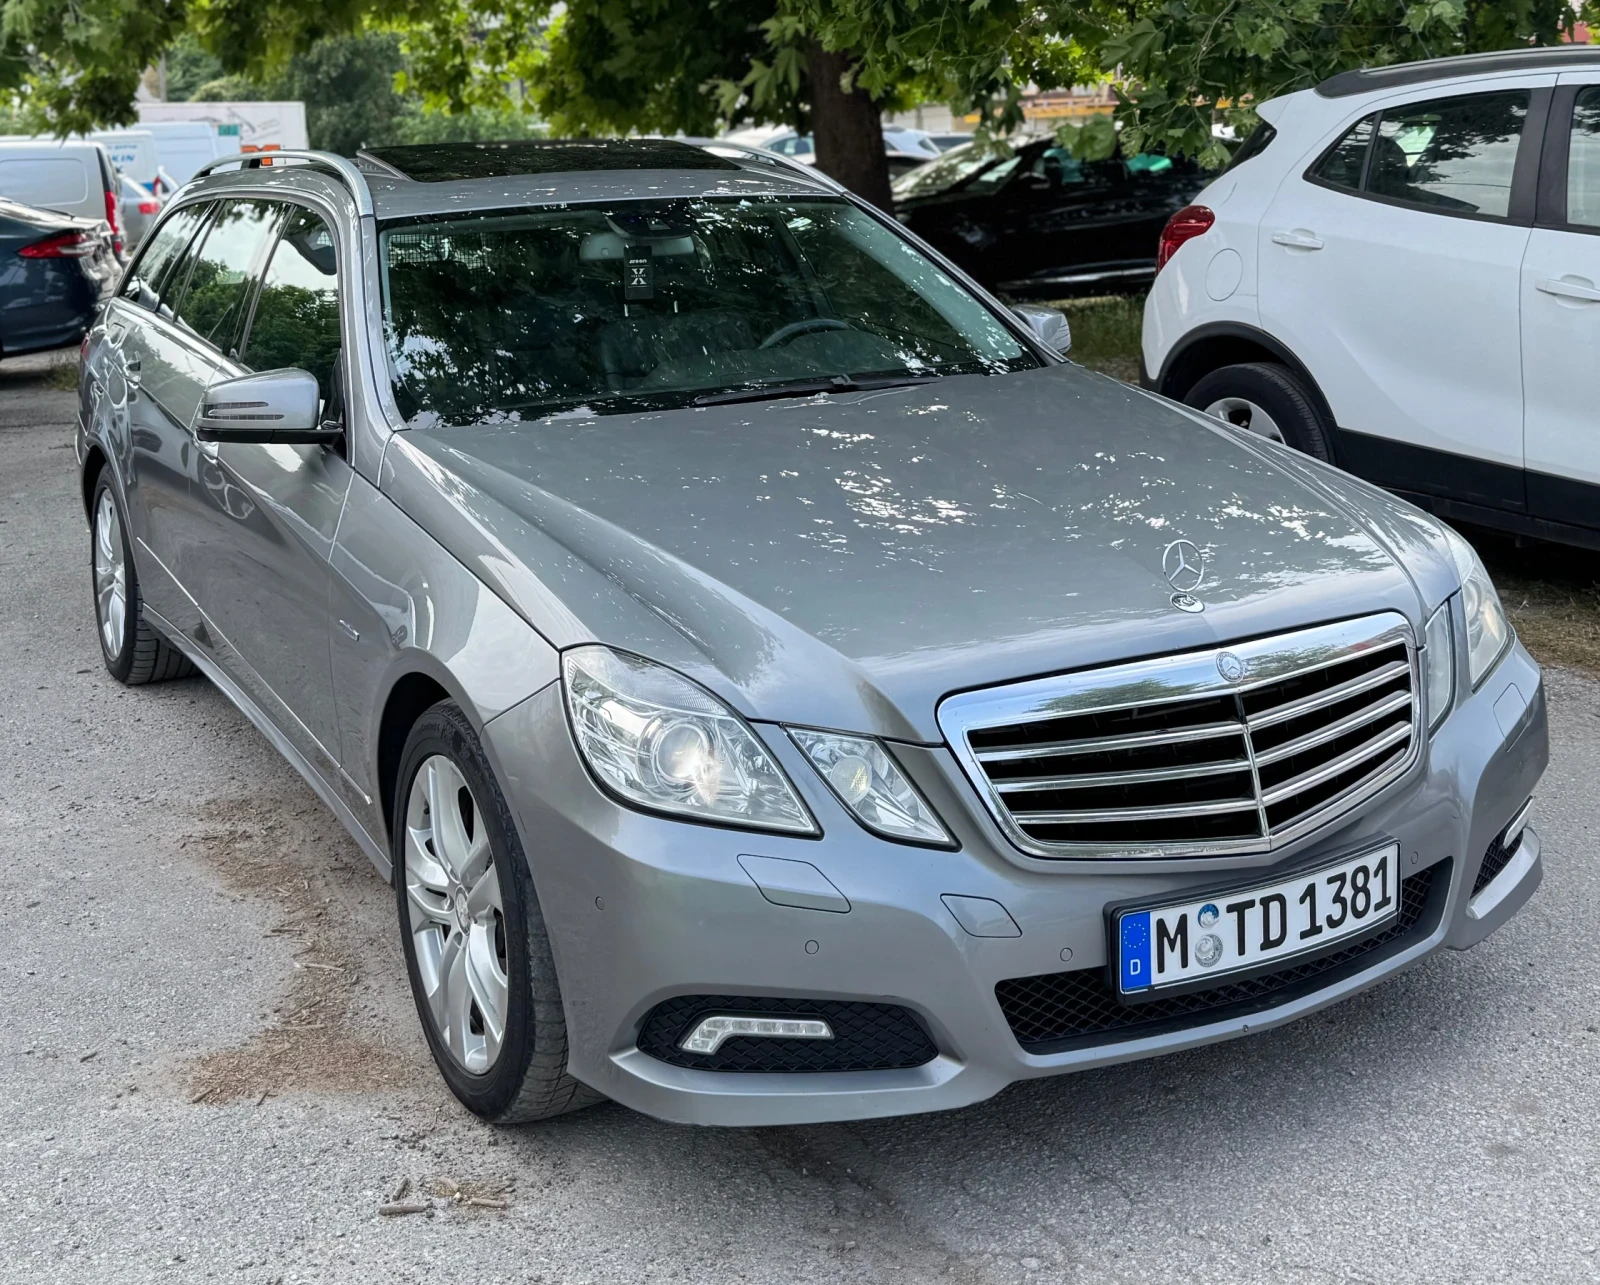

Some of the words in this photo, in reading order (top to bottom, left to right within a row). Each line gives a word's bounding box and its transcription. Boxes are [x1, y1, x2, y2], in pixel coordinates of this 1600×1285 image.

[1156, 913, 1189, 974] M
[1226, 893, 1287, 956] TD
[1299, 856, 1392, 940] 1381
[1130, 959, 1141, 975] D
